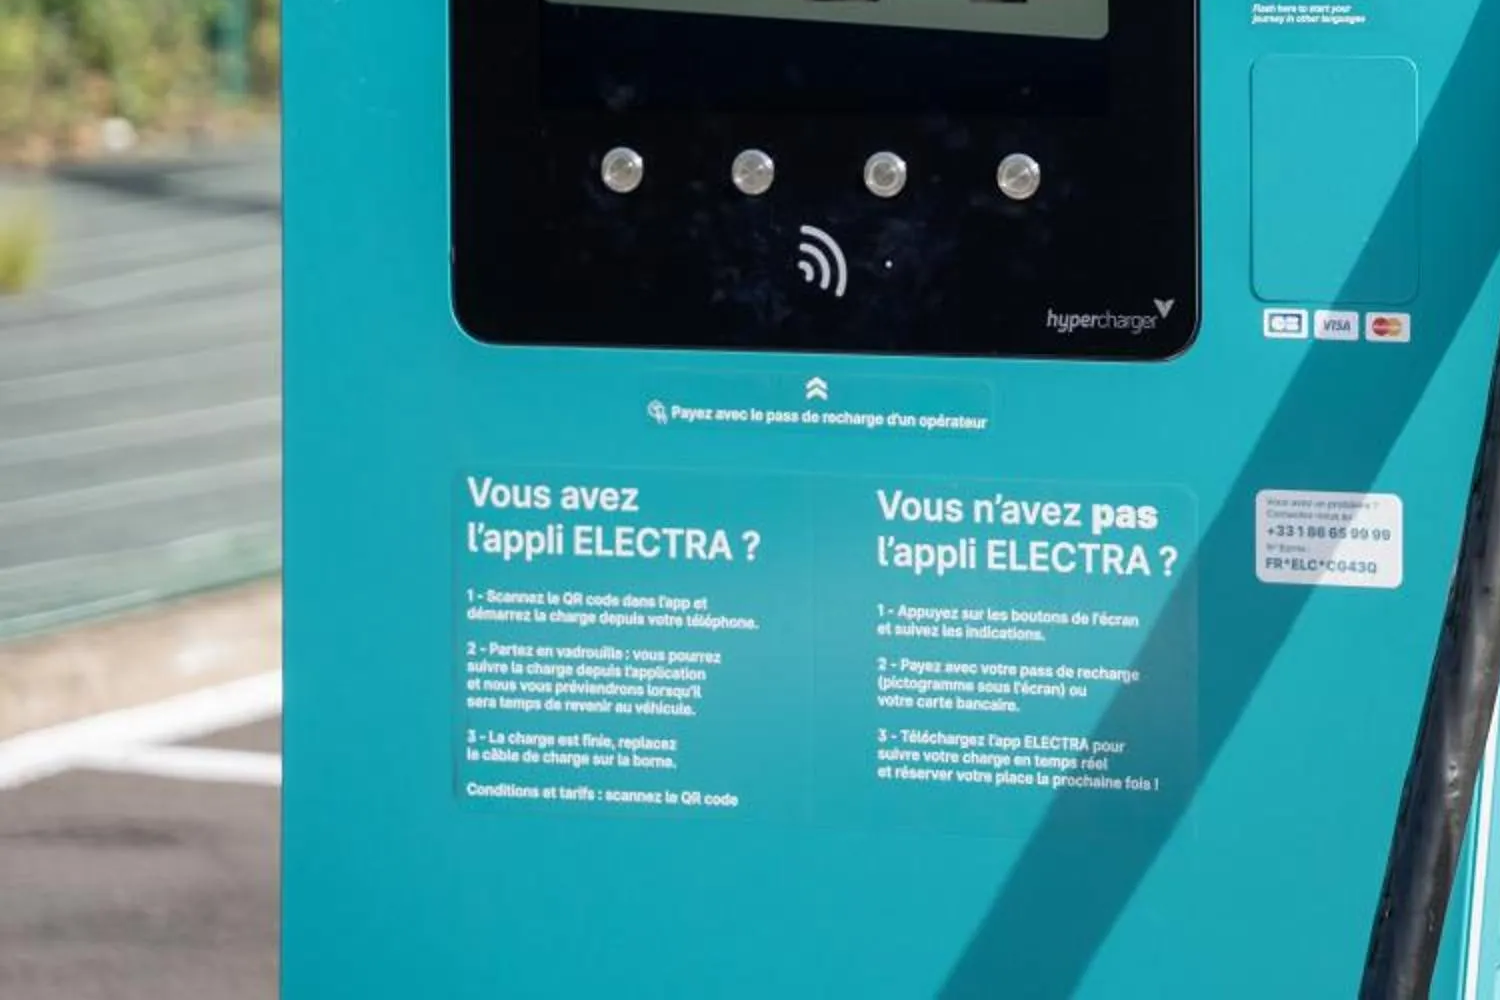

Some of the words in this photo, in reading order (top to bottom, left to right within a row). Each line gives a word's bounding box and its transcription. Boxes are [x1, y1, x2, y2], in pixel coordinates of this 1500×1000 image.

[1046, 309, 1158, 332] hypercharger
[1324, 320, 1350, 331] VISA
[671, 405, 714, 422] Payez
[715, 409, 748, 421] avec
[750, 409, 763, 422] le
[765, 412, 799, 426] pass
[802, 411, 819, 423] de
[822, 412, 884, 429] recharge
[919, 414, 989, 430] opérateur
[467, 476, 551, 509] Vous
[560, 486, 639, 512] avez
[877, 489, 963, 523] Vous
[974, 494, 1081, 526] n'avez
[1091, 503, 1158, 534] pas
[573, 525, 734, 561] ELECTRA
[742, 530, 761, 561] ?
[986, 540, 1150, 576] ELECTRA
[1159, 546, 1178, 577] ?
[467, 589, 473, 602] 1
[487, 590, 544, 605] Scannez
[547, 592, 559, 605] le
[563, 593, 582, 606] QR
[586, 594, 619, 607] code
[622, 595, 656, 608] dans
[694, 597, 707, 610] et
[467, 607, 530, 621] démarrez
[534, 609, 546, 621] la
[550, 610, 596, 626] charge
[600, 611, 644, 627] depuis
[648, 617, 683, 626] votre
[687, 613, 759, 631] téléphone.
[877, 604, 884, 617] 1
[898, 606, 958, 622] Appuyez
[961, 610, 984, 621] sur
[987, 609, 1008, 621] les
[1011, 609, 1069, 624] boutons
[1071, 612, 1089, 625] de
[877, 623, 891, 635] et
[895, 624, 939, 637] suivez
[942, 625, 962, 637] les
[965, 627, 1045, 641] indications.
[467, 642, 476, 656] 2
[490, 642, 533, 657] Partez
[536, 646, 552, 657] en
[556, 644, 622, 660] vadrouille
[633, 650, 665, 661] vous
[668, 651, 721, 664] pourrez
[467, 660, 508, 674] suivre
[512, 661, 523, 674] la
[527, 662, 573, 678] charge
[576, 664, 621, 679] depuis
[877, 658, 887, 671] 2
[900, 658, 942, 674] Payez
[945, 663, 977, 674] avec
[981, 665, 1016, 676] votre
[1020, 666, 1053, 679] pass
[1056, 665, 1074, 678] de
[1077, 667, 1139, 683] recharge
[467, 679, 480, 690] et
[483, 682, 516, 692] nous
[520, 682, 552, 692] vous
[877, 675, 974, 692] (pictogramme
[978, 681, 1010, 693] sous
[1069, 685, 1087, 697] ou
[468, 698, 497, 708] sera
[500, 698, 541, 712] temps
[544, 698, 562, 710] de
[566, 700, 611, 712] revenir
[616, 703, 632, 713] au
[635, 700, 696, 715] véhicule.
[877, 695, 913, 707] votre
[916, 697, 953, 709] carte
[956, 697, 1020, 712] bancaire.
[467, 730, 476, 743] 3
[489, 731, 504, 744] La
[508, 732, 554, 749] charge
[557, 735, 580, 746] est
[582, 734, 616, 750] finie,
[618, 737, 677, 752] replacez
[877, 729, 887, 742] 3
[901, 729, 985, 749] Téléchargez
[1024, 735, 1089, 751] ELECTRA
[1092, 742, 1125, 754] pour
[467, 748, 479, 761] le
[482, 748, 519, 762] câble
[522, 749, 540, 763] de
[543, 752, 589, 768] charge
[592, 755, 614, 766] sur
[617, 754, 630, 766] la
[633, 755, 677, 769] borne.
[877, 750, 921, 761] suivre
[922, 752, 959, 763] votre
[962, 753, 1011, 769] charge
[1013, 755, 1031, 766] en
[1034, 755, 1077, 771] temps
[1080, 757, 1109, 770] réel
[877, 765, 892, 778] et
[895, 766, 953, 780] réserver
[956, 770, 992, 782] votre
[995, 770, 1033, 787] place
[1036, 772, 1049, 785] la
[1052, 773, 1122, 790] prochaine
[1125, 776, 1151, 791] fois
[466, 782, 539, 797] Conditions
[543, 787, 557, 798] et
[560, 787, 595, 800] tarifs
[605, 791, 661, 803] scannez
[665, 791, 678, 803] le
[681, 791, 702, 804] QR
[704, 793, 738, 806] code
